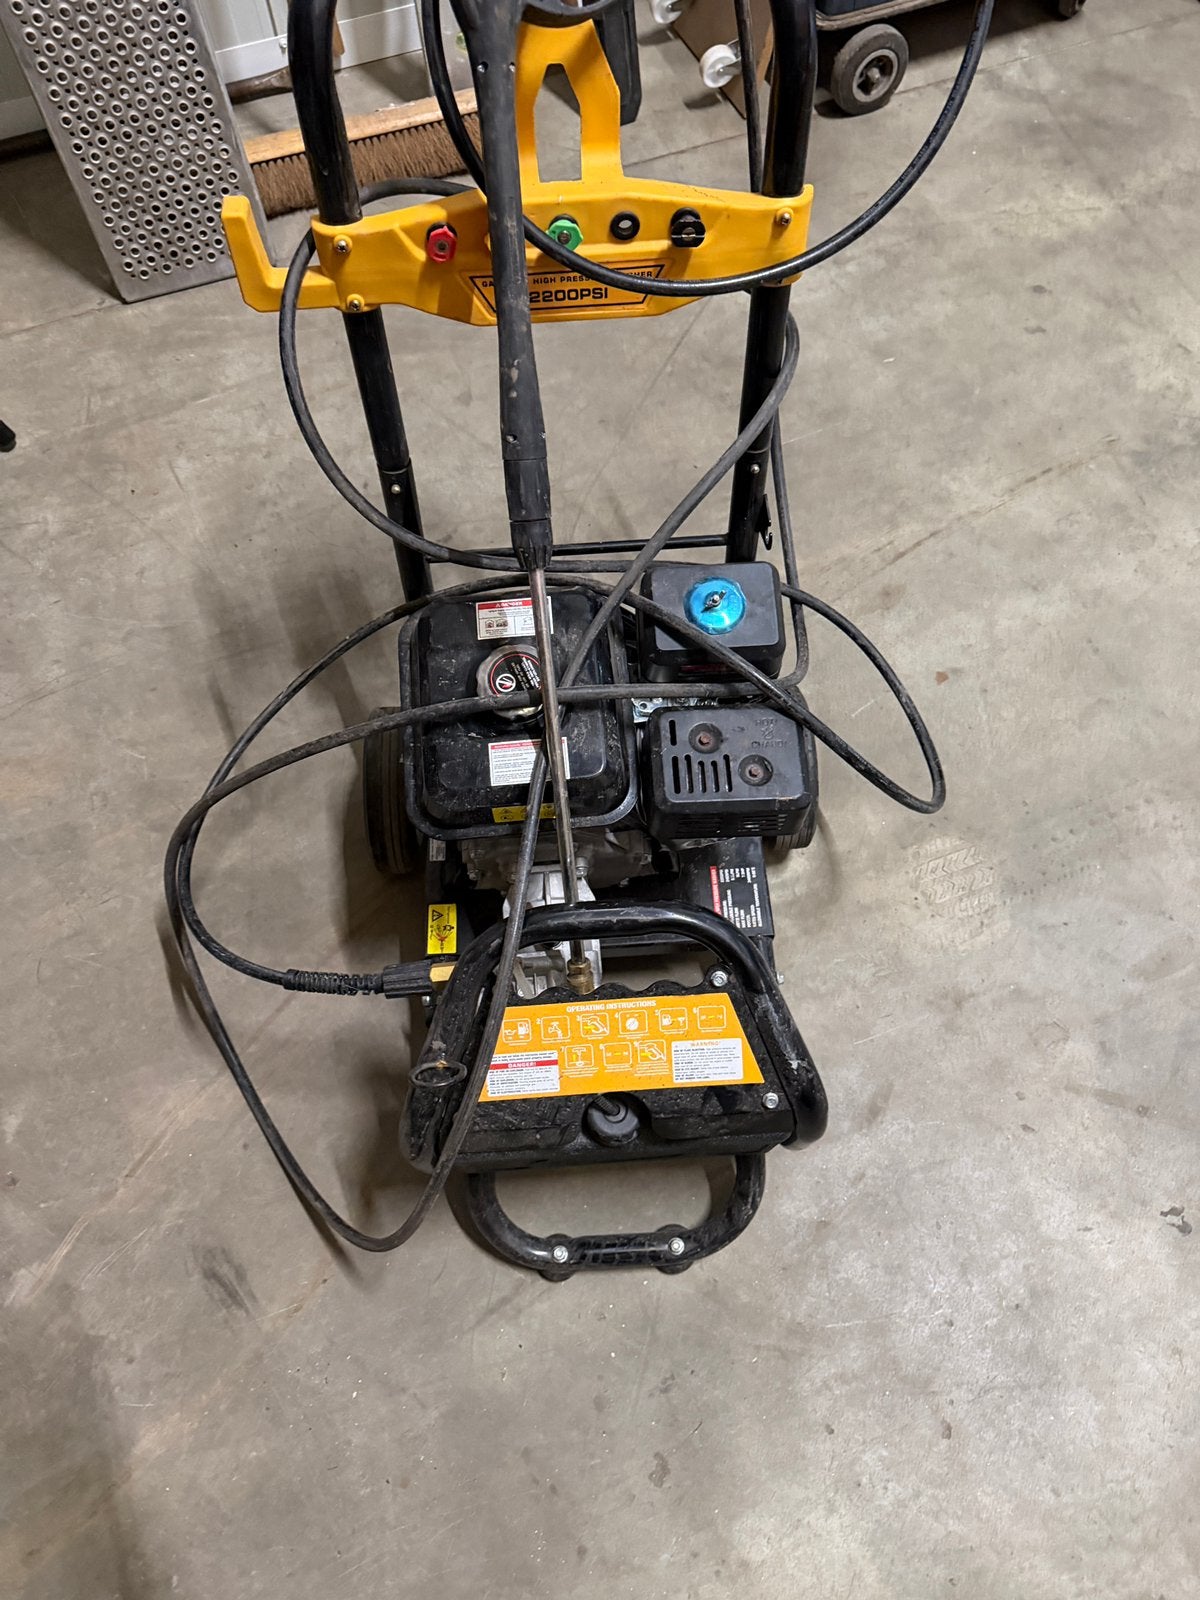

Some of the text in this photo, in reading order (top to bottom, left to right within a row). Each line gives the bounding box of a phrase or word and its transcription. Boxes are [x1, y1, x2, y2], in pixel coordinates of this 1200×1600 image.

[529, 287, 608, 303] 2200PSI
[566, 1000, 656, 1012] OPERATING INSTRUCTIONS
